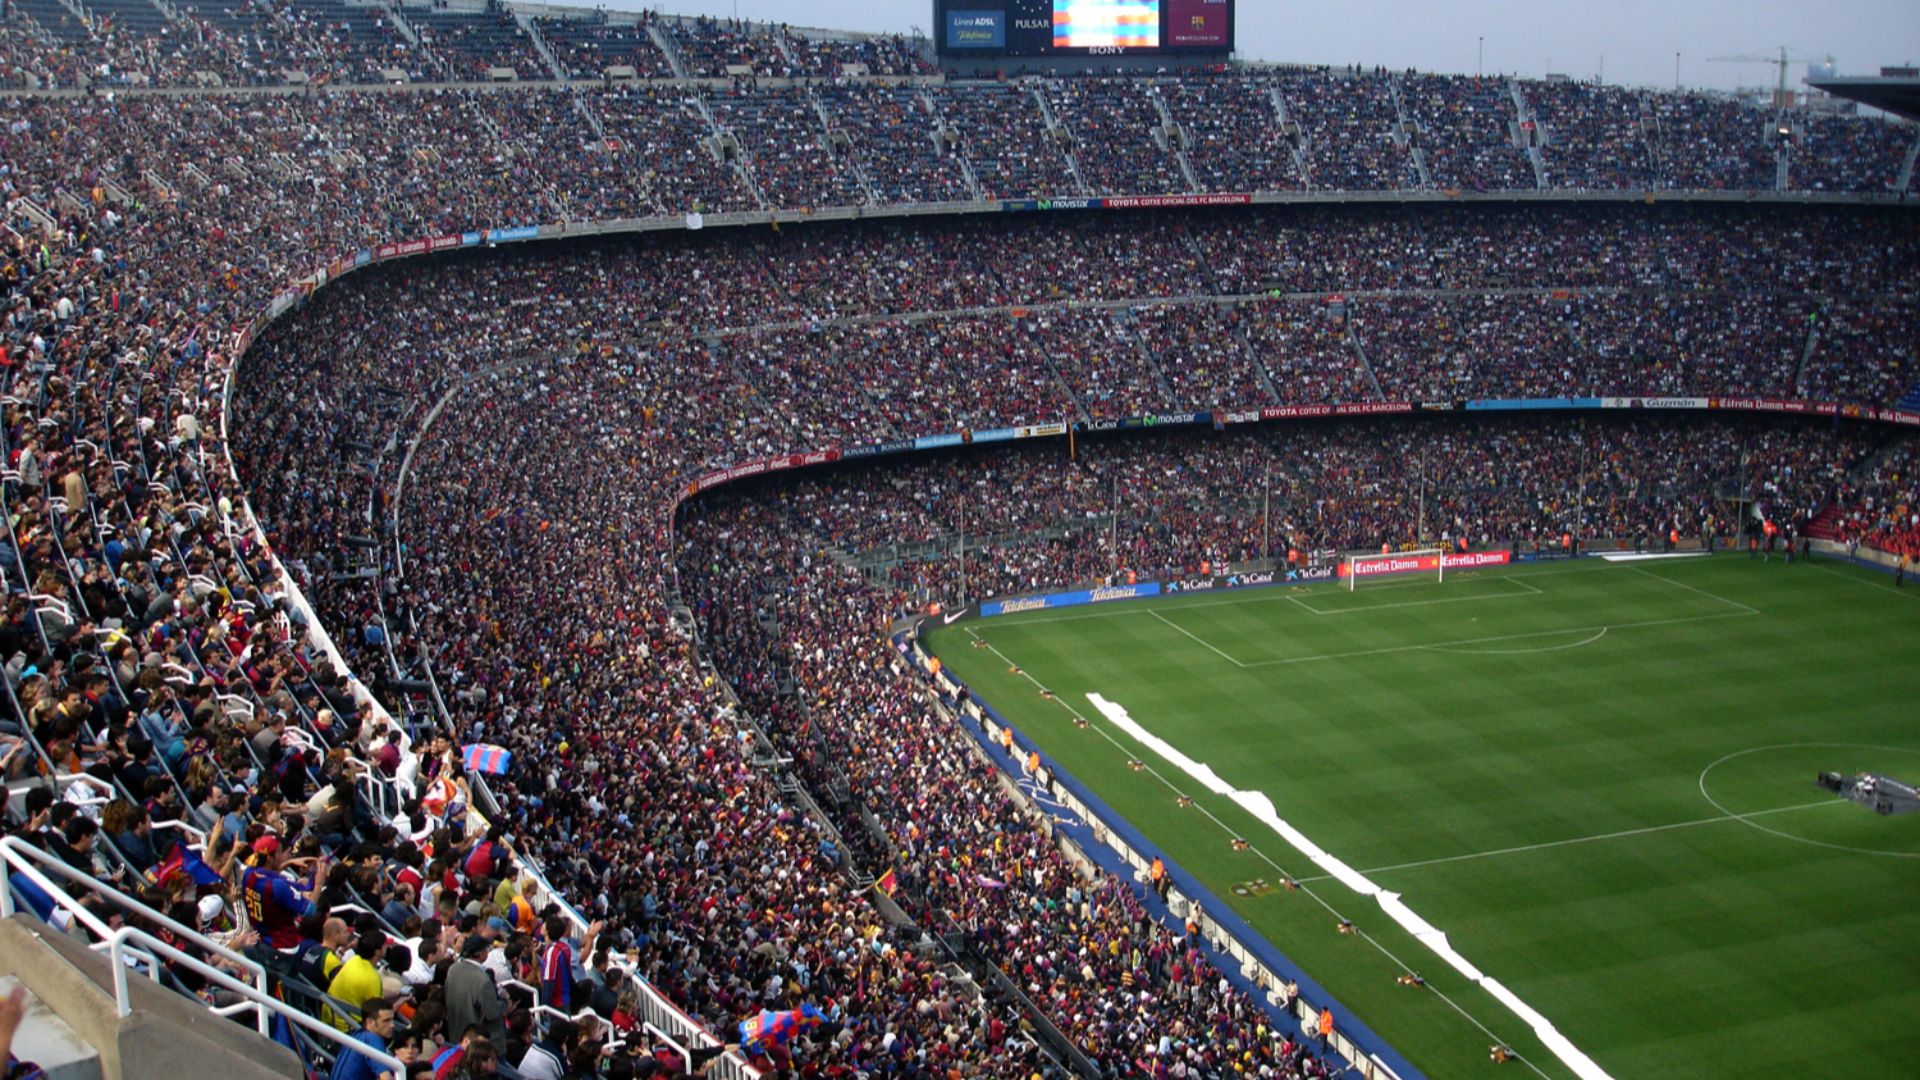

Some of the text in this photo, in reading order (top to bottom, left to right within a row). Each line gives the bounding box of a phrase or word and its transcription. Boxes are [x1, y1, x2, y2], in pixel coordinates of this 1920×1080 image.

[974, 17, 995, 26] ADSL
[1015, 19, 1050, 28] PULSAR
[1088, 46, 1125, 54] SONY
[1052, 199, 1089, 208] movistar
[1108, 199, 1139, 207] TOYOTA
[1208, 195, 1246, 204] BARCELONA
[1264, 408, 1297, 417] TOYOTA
[1298, 407, 1320, 416] COTXE
[1348, 404, 1360, 412] DEL
[1372, 402, 1412, 411] BARCELONA
[1719, 398, 1753, 408] Estrella
[1756, 399, 1784, 410] Damm
[1157, 413, 1195, 424] movistar
[1442, 553, 1503, 566] Estrella Damm
[1355, 559, 1418, 574] Estrella Damm
[245, 896, 264, 923] 20
